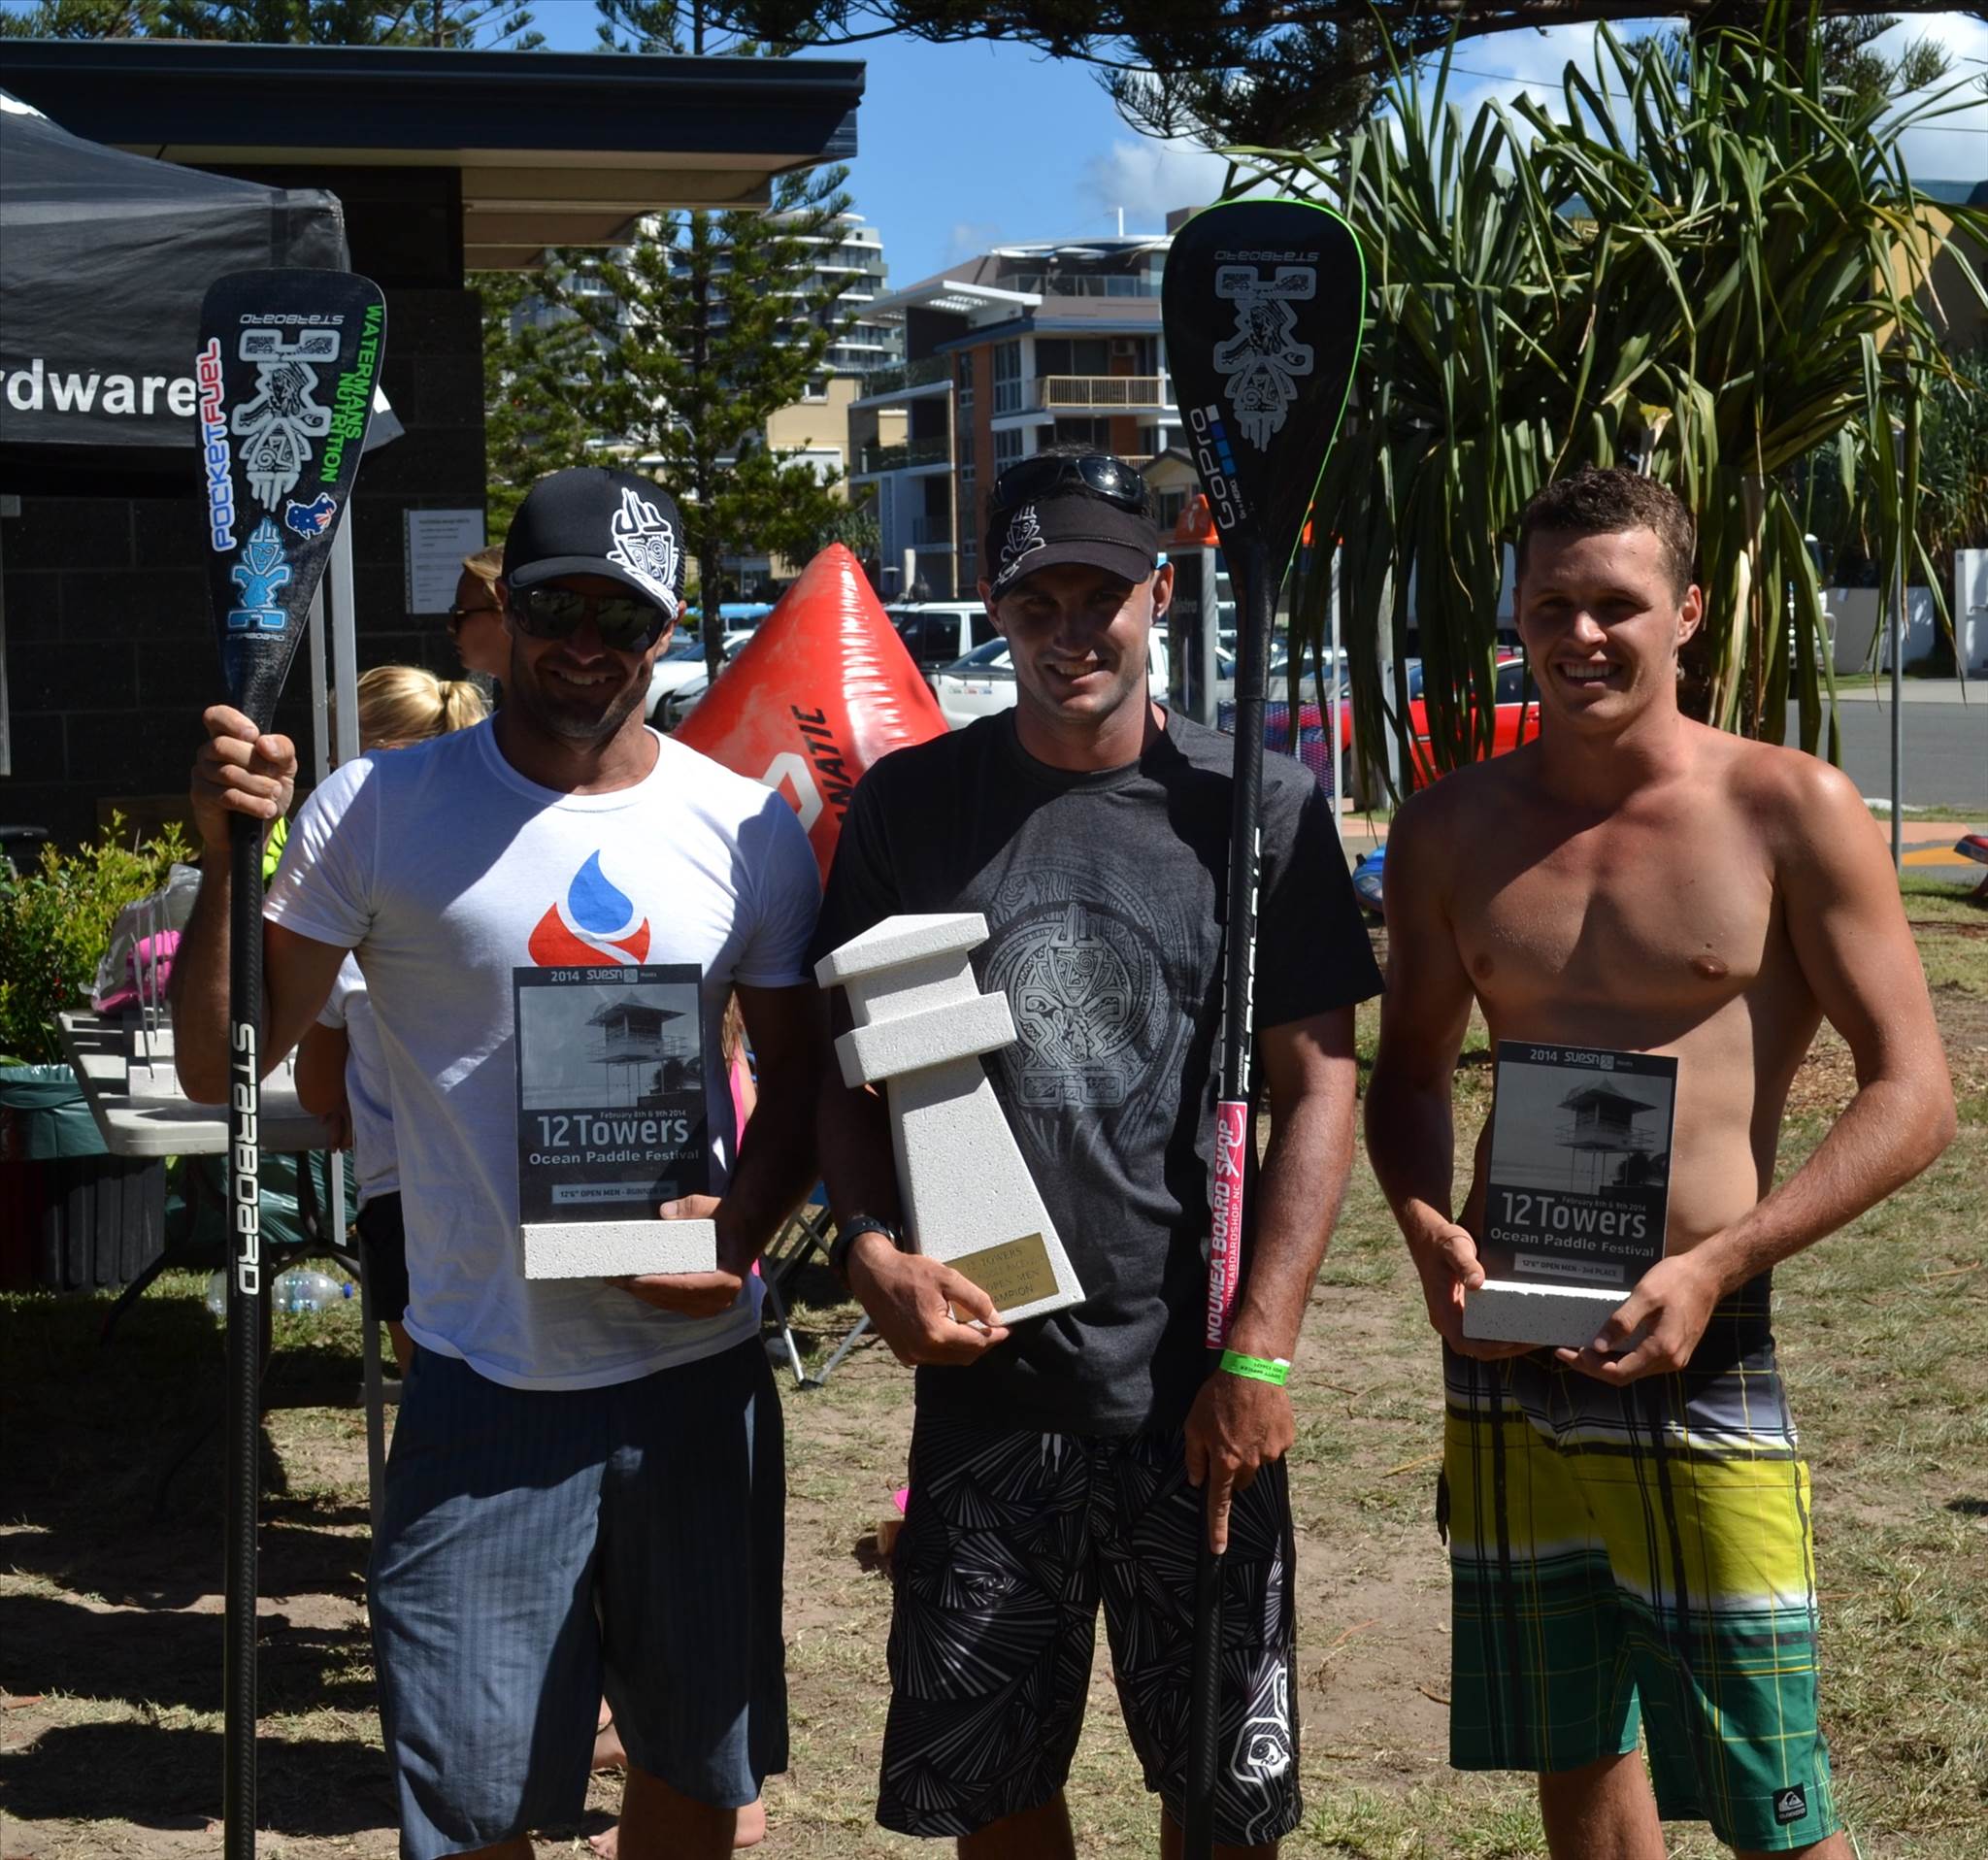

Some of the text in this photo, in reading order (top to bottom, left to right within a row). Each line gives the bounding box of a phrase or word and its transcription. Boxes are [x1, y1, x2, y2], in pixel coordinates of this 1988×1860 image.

[0, 358, 196, 416] dware
[346, 305, 383, 441] WATERMANS
[320, 372, 349, 482] NUTRITION
[790, 704, 854, 823] NATIC
[551, 971, 580, 982] 2014
[1530, 1048, 1557, 1061] 2014
[529, 1148, 699, 1165] Ocean Paddle Festival
[1216, 1119, 1235, 1177] SHOP
[581, 1189, 603, 1198] OPEN
[604, 1188, 620, 1197] MEN
[1212, 1181, 1230, 1253] BOARD
[1490, 1227, 1655, 1257] Ocean Paddle Festival
[993, 1284, 1034, 1304] AMPION
[1207, 1258, 1226, 1343] NOUMEA
